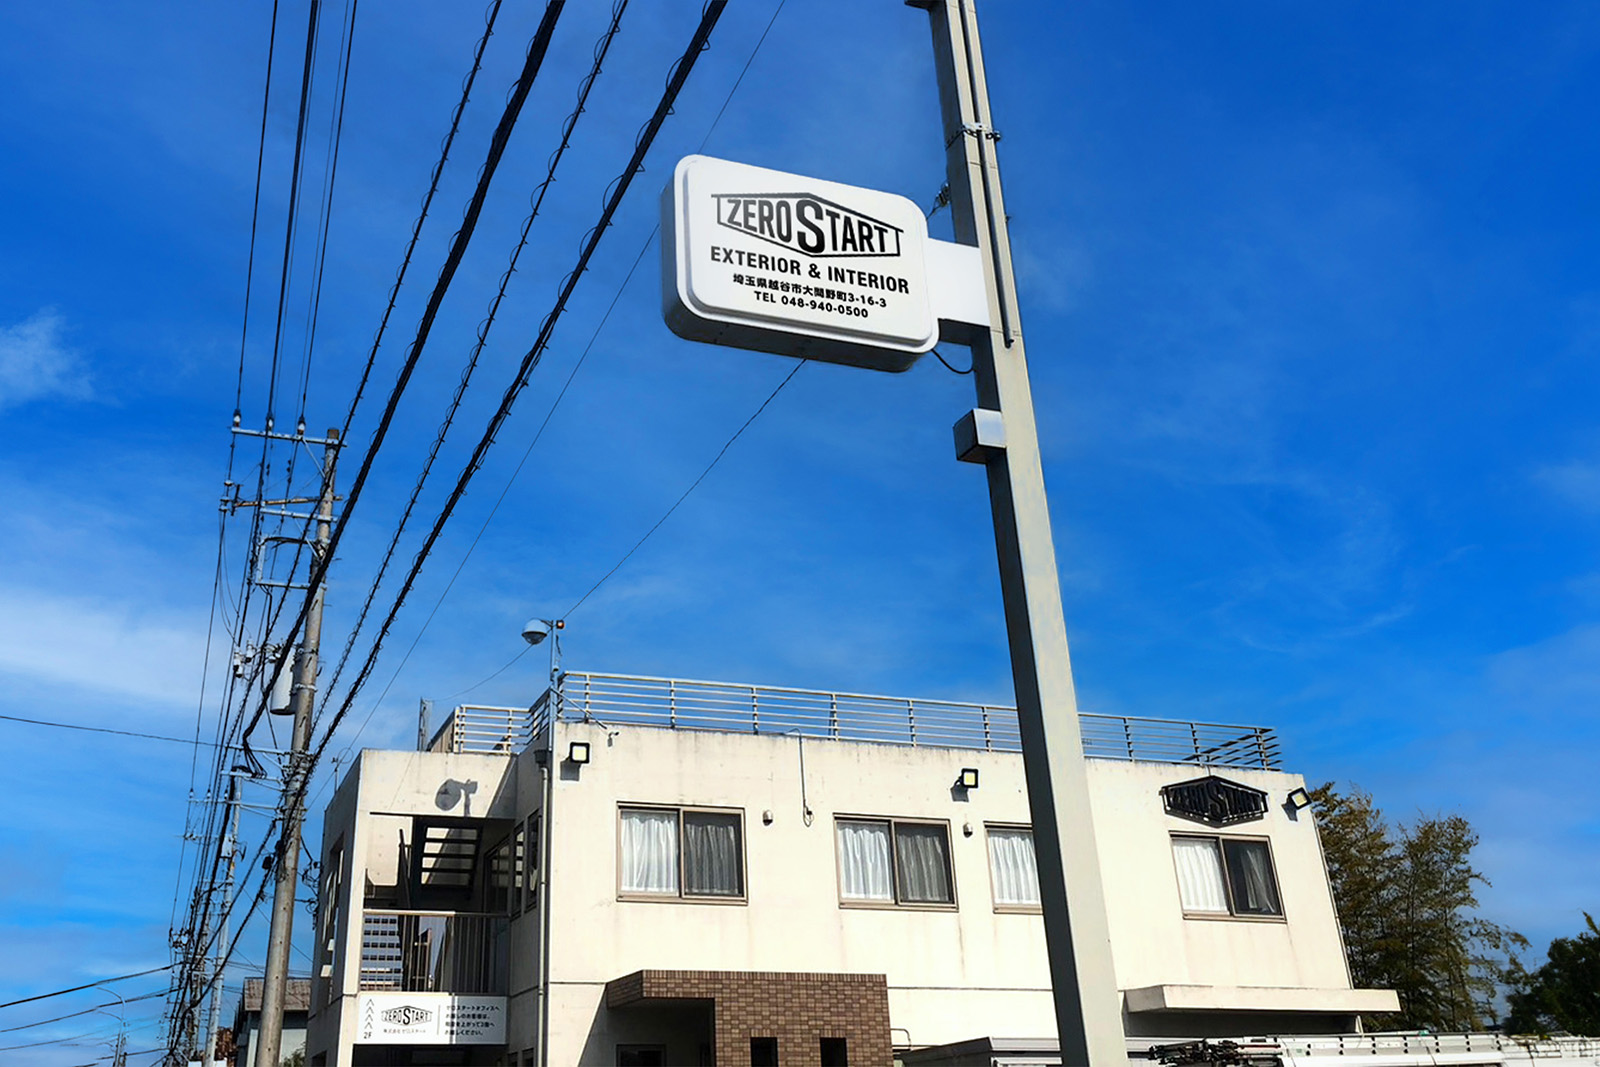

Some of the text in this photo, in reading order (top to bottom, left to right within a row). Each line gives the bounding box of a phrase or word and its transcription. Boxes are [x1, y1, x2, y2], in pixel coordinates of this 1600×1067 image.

[727, 199, 888, 254] ZERO START
[711, 246, 910, 294] EXTERIOR & INTERIOR
[754, 291, 869, 318] TEL 048-940-0500
[384, 1008, 428, 1025] ZERO START
